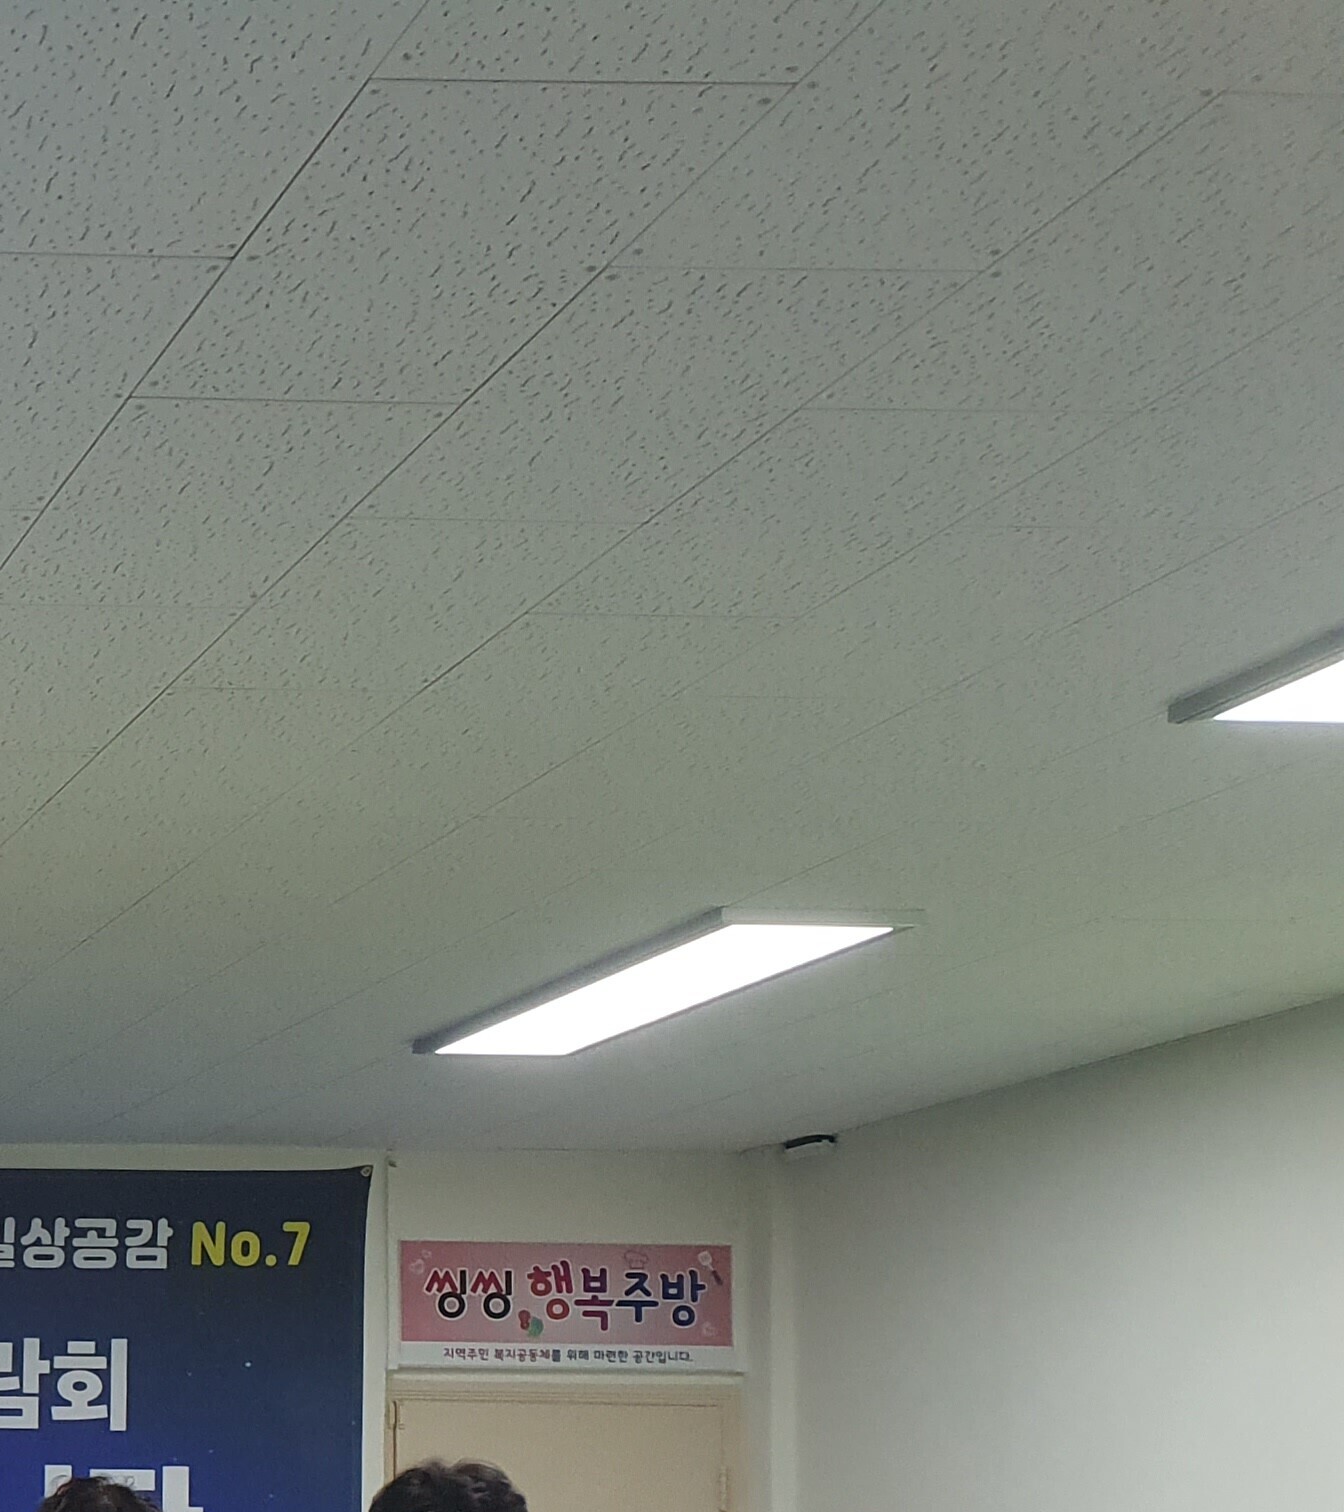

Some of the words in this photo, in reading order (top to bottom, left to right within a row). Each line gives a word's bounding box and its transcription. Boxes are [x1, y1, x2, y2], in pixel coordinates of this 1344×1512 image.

[191, 1221, 311, 1267] No.7
[425, 1268, 513, 1319] 씽씽
[527, 1260, 707, 1331] 행복주방
[443, 1349, 489, 1361] 지역주민
[567, 1349, 589, 1361] 위해
[593, 1350, 629, 1362] 마련한
[633, 1350, 693, 1363] 공간입니다.
